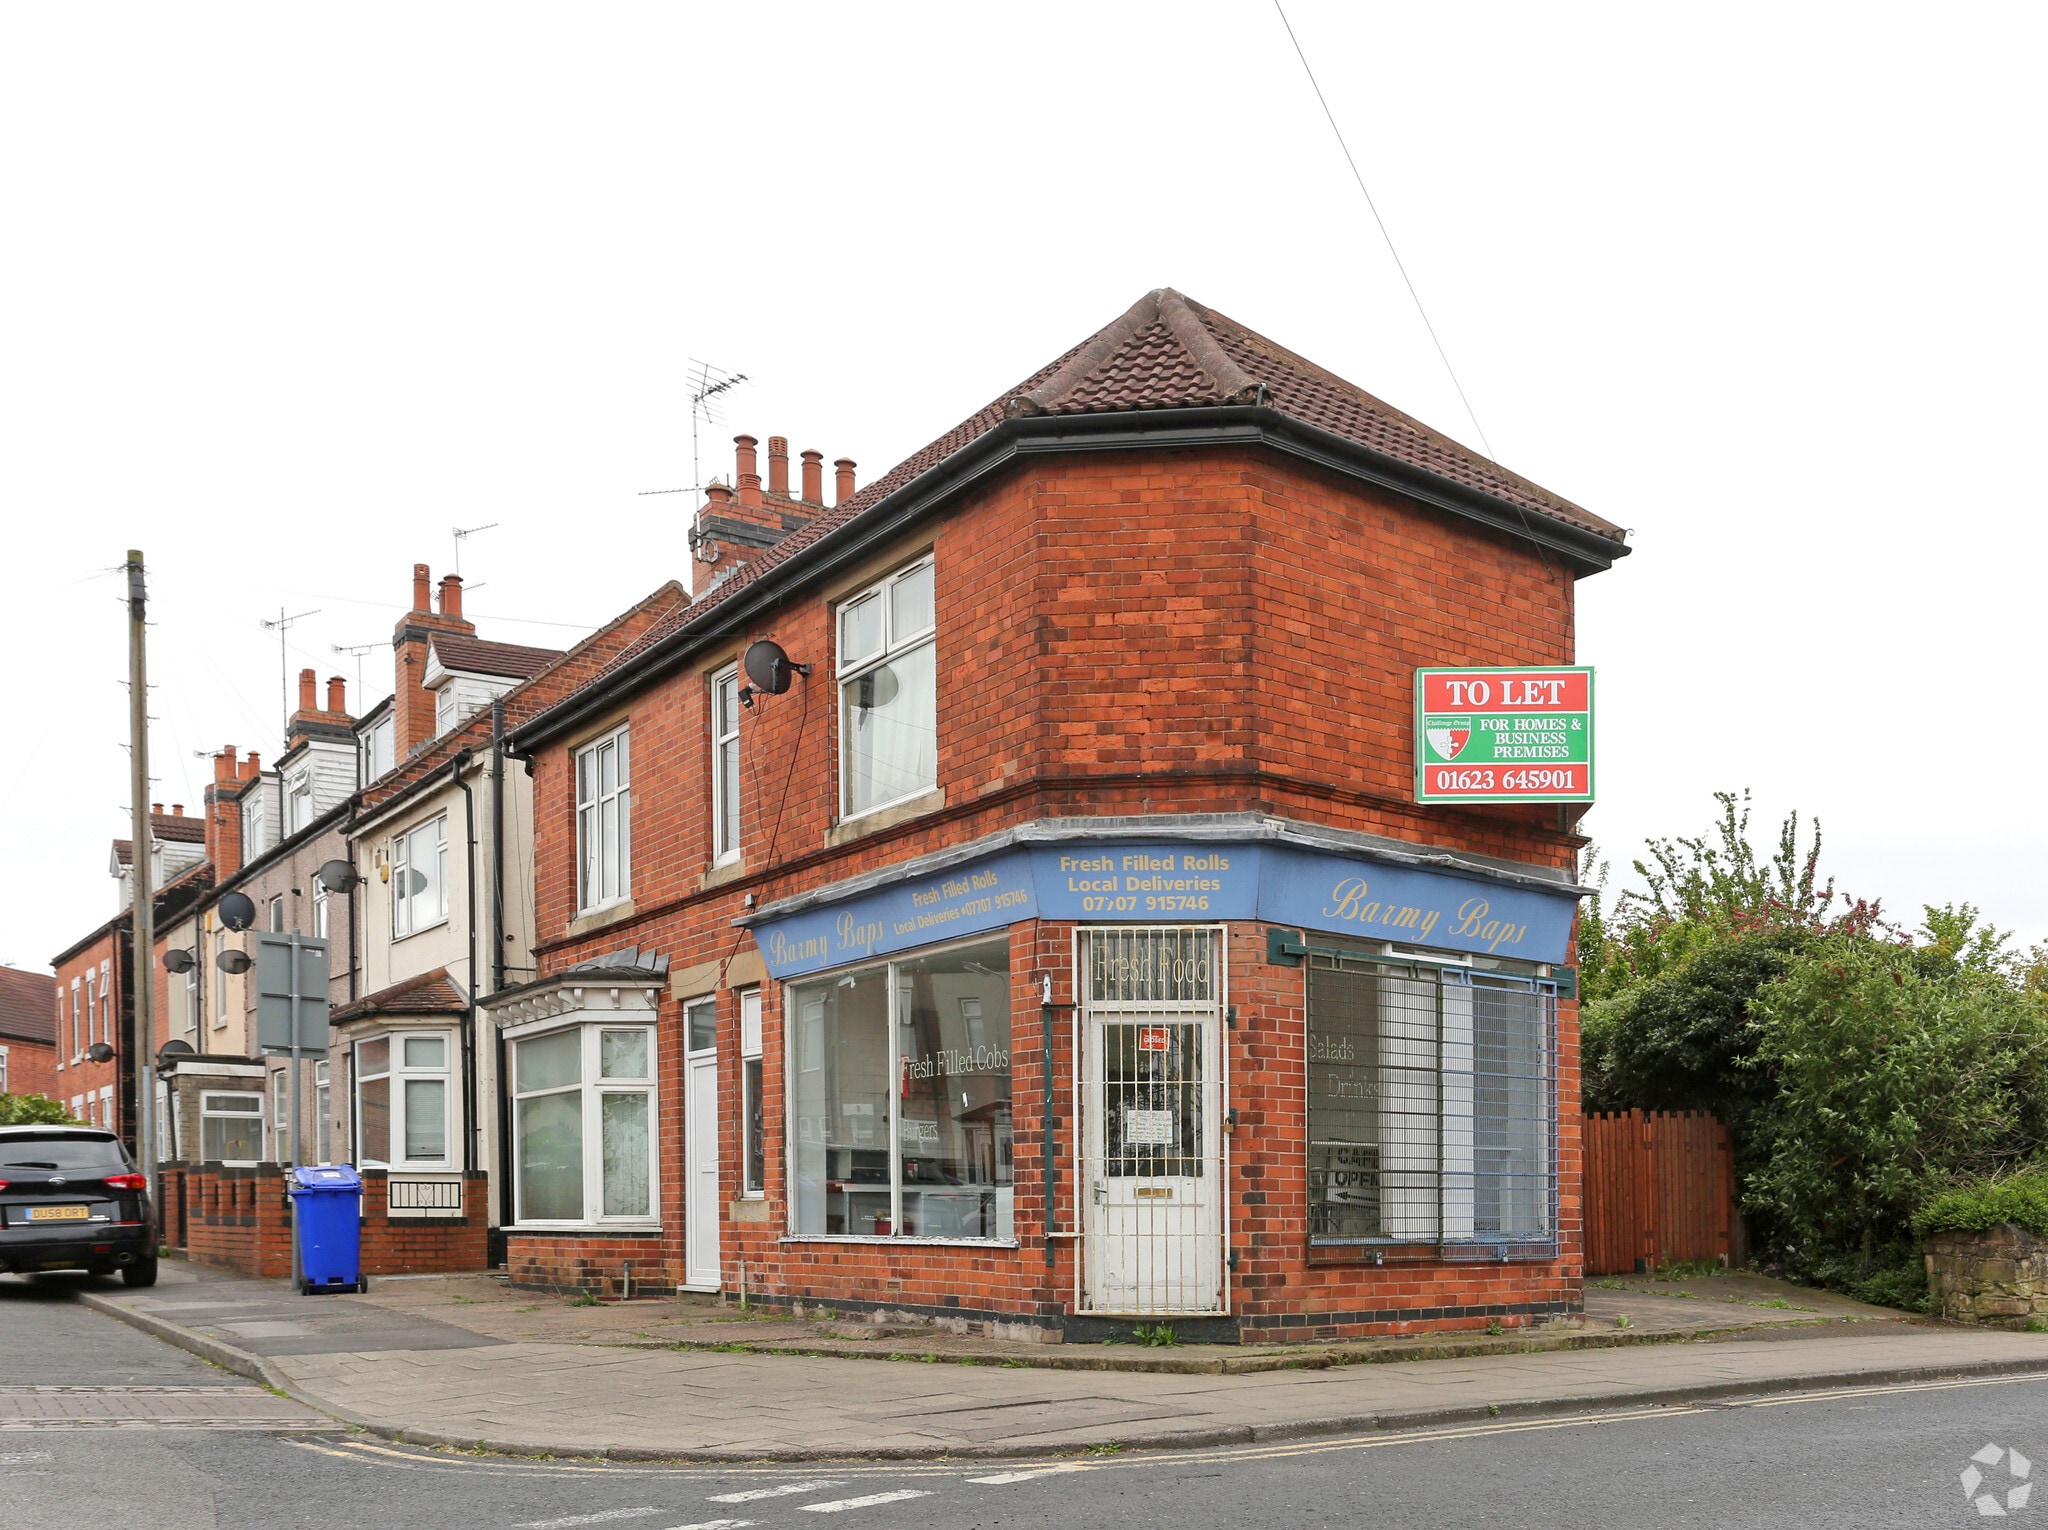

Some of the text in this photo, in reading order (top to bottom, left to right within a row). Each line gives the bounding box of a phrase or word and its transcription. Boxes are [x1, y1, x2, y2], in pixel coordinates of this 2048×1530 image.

[1446, 680, 1566, 706] TO LET
[1479, 718, 1582, 731] FOR HOMES &
[1494, 732, 1567, 745] BUSINESS
[1493, 746, 1569, 759] PREMISES
[1437, 770, 1575, 790] 01623 645901
[1060, 854, 1230, 872] Fresh Filled Rolls
[912, 869, 998, 908] Fresh Filled Rolls
[1068, 875, 1221, 892] Local Deliveries
[893, 917, 916, 935] Local
[917, 907, 960, 929] Deliveries
[994, 888, 1028, 909] 915746
[1083, 896, 1209, 911] 07707 915746
[1322, 877, 1527, 952] Barmy Baps
[770, 911, 883, 967] Barmy Baps
[1094, 945, 1210, 983] Fresh Food
[901, 1043, 1009, 1081] Fresh Filled Cobs
[903, 1121, 938, 1143] Burgers
[65, 1207, 86, 1217] ORT
